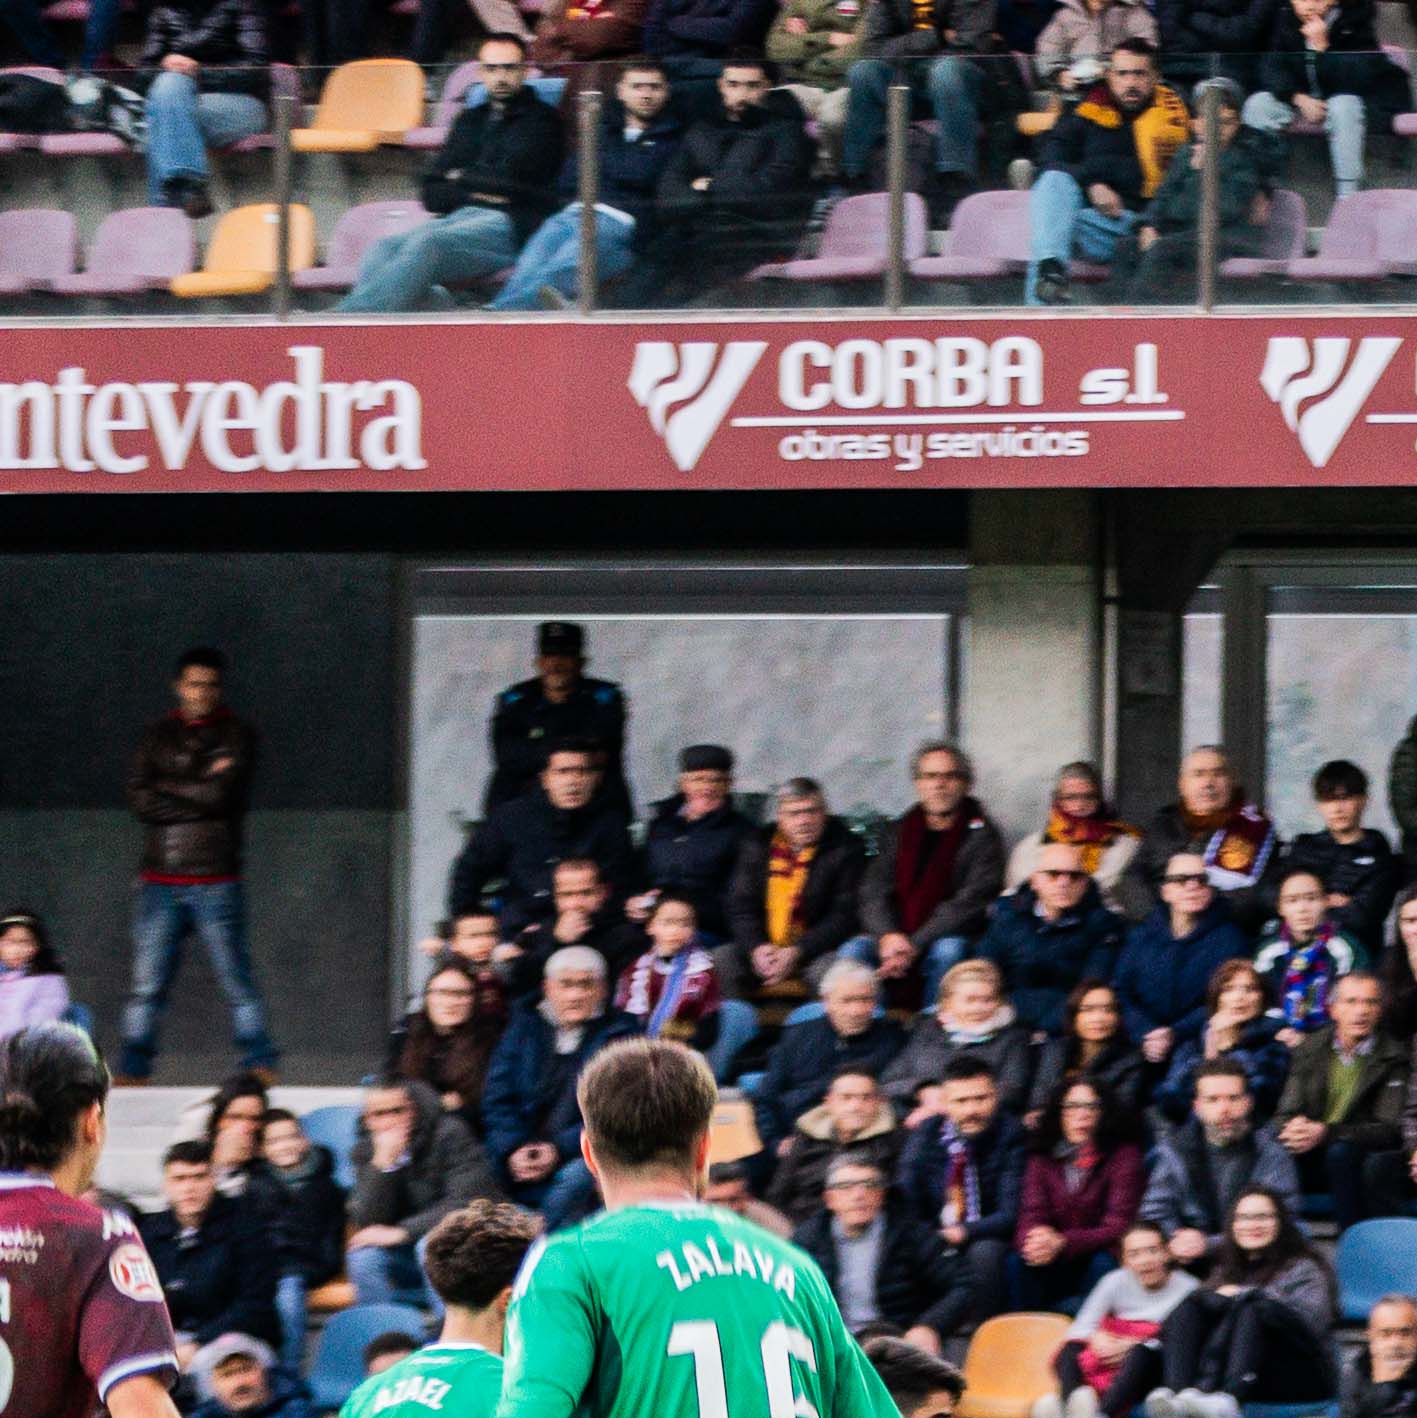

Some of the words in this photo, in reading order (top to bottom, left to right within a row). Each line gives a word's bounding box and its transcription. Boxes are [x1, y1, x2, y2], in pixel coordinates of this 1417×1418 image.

[778, 336, 1044, 410] CORBA
[779, 429, 891, 461] obras
[893, 431, 923, 471] y
[926, 426, 1089, 460] servicios
[656, 1234, 795, 1301] ZALAYA
